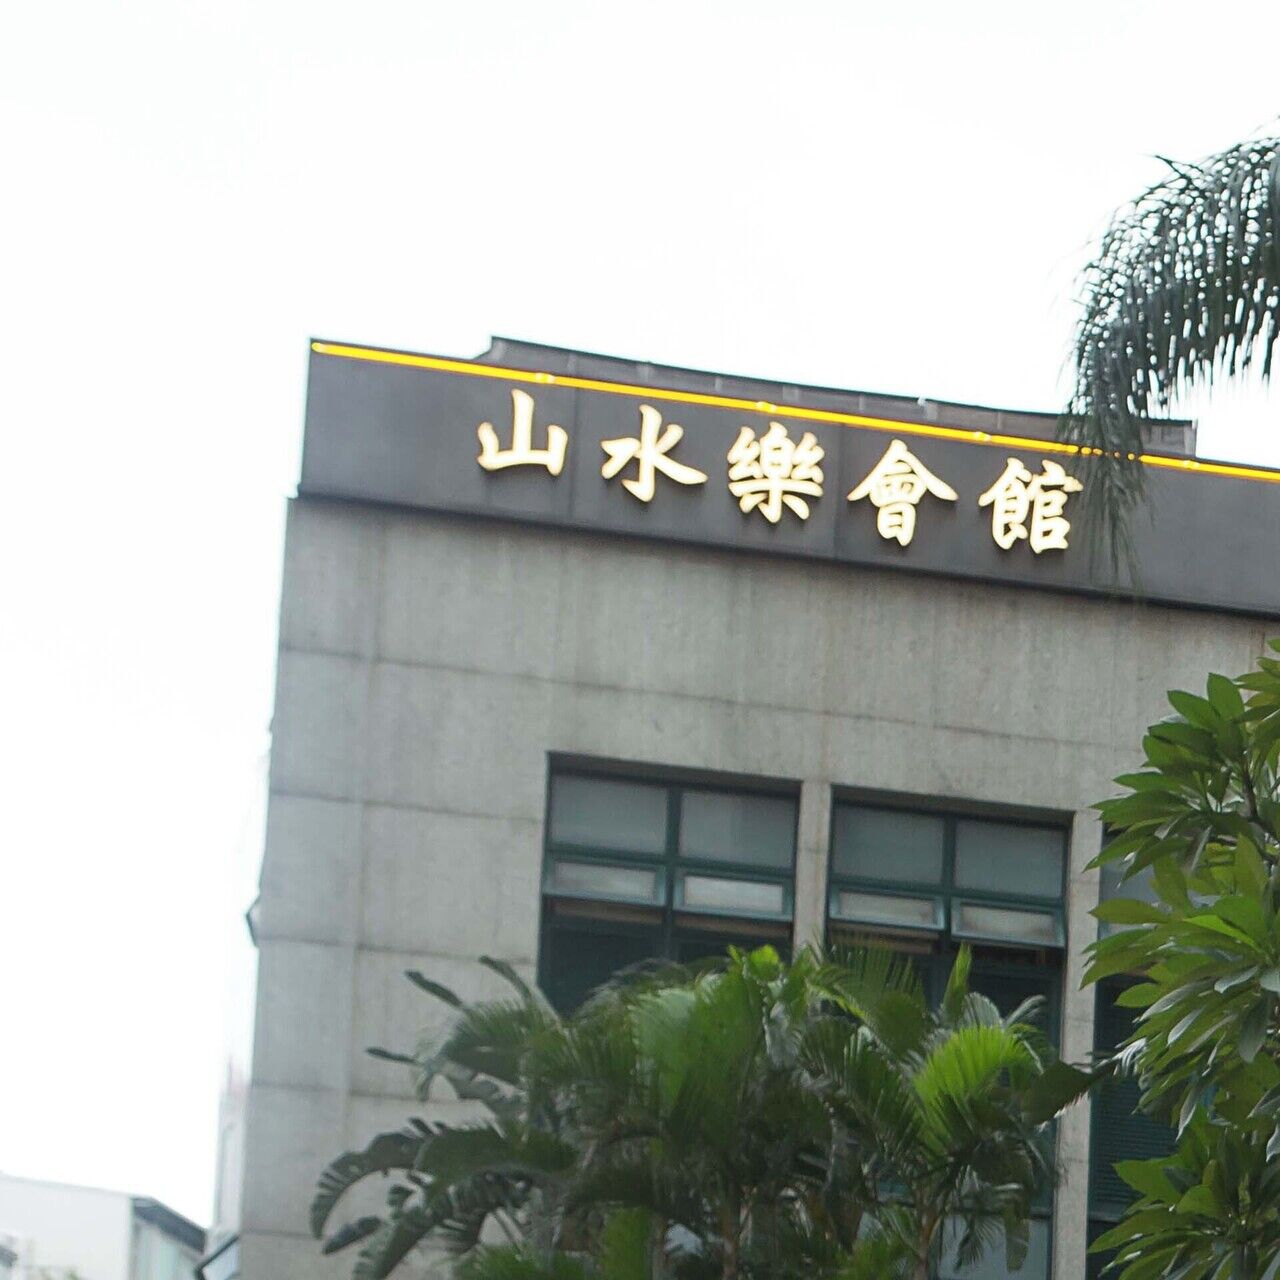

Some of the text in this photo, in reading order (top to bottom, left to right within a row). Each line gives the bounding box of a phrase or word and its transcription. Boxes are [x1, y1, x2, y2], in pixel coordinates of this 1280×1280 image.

[477, 388, 1084, 554] 山水樂會館
